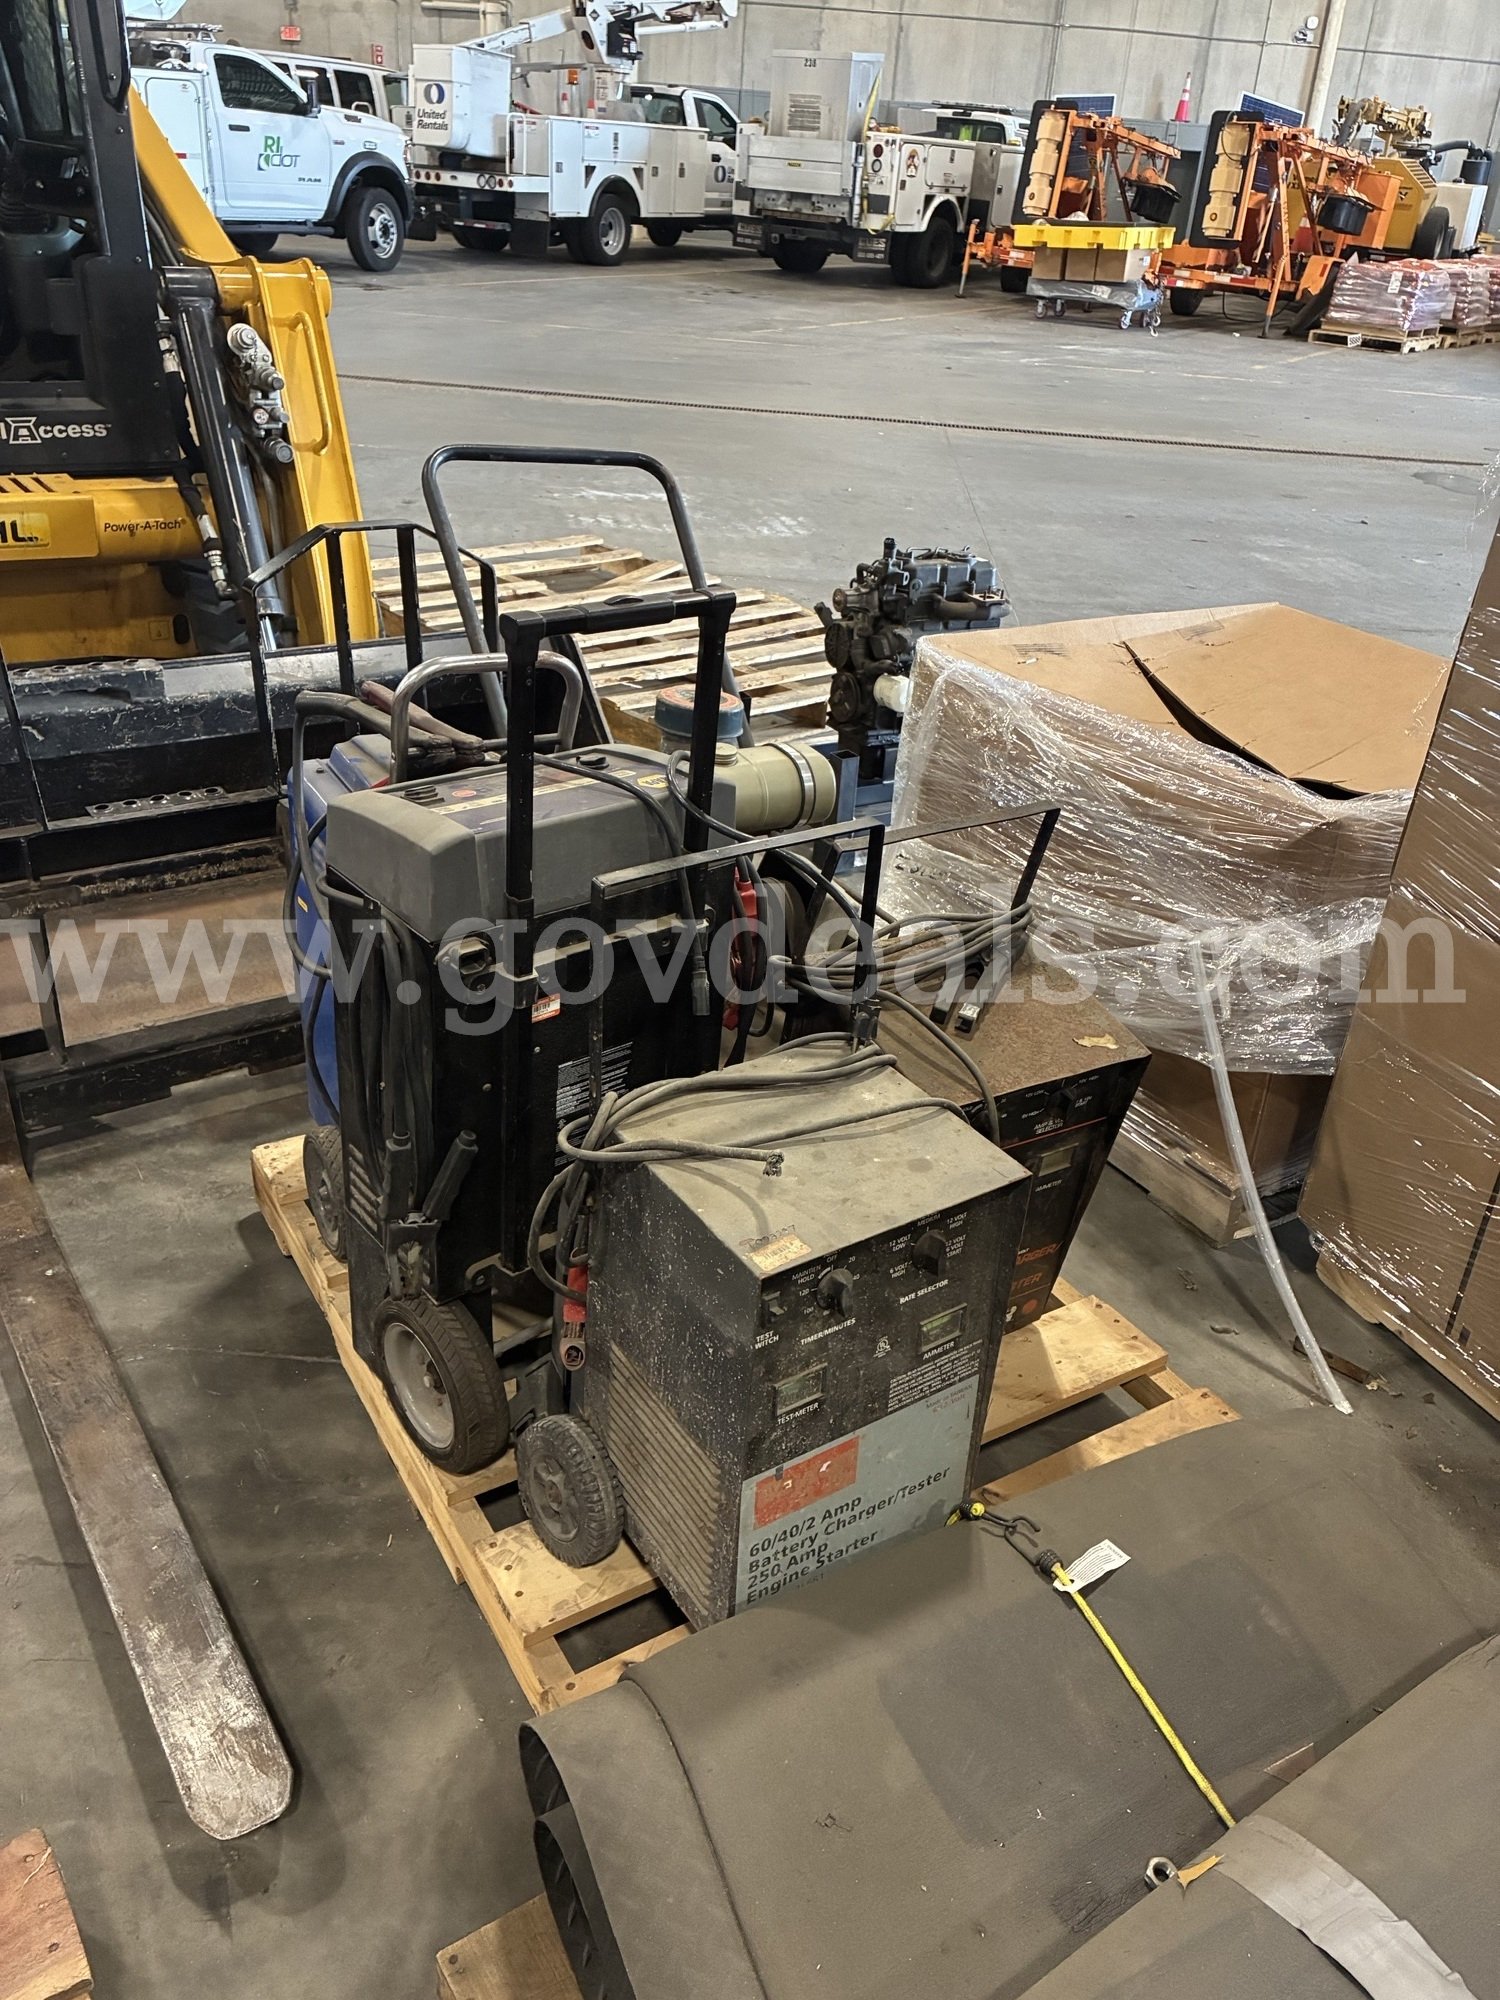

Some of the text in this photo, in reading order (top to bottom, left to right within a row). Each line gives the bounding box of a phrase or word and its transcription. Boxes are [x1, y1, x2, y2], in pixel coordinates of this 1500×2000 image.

[417, 109, 447, 120] United
[416, 119, 448, 131] Rentals
[264, 136, 281, 153] RI
[104, 519, 182, 533] Power-A-Tach
[1035, 1179, 1063, 1192] AMMETER
[917, 1213, 941, 1227] MEDIUM
[954, 1212, 968, 1223] VOLT
[896, 1234, 911, 1246] VOLT
[950, 1241, 964, 1251] VOLT
[953, 1234, 966, 1246] VOLT
[892, 1242, 906, 1252] LOW
[826, 1255, 838, 1263] OFF
[894, 1262, 908, 1272] VOLT
[798, 1273, 815, 1284] HOLD
[891, 1269, 906, 1279] HIGH
[799, 1288, 810, 1297] 120
[900, 1278, 949, 1304] RATE SELECTOR
[756, 1330, 774, 1342] TEST
[800, 1317, 856, 1345] TIMER/MINUTES
[922, 1341, 955, 1360] AMMETER
[748, 1467, 950, 1574] Battery Charger/Tester
[749, 1496, 862, 1558] 60/40/2 Amp
[747, 1567, 782, 1590] 250
[787, 1541, 829, 1575] Amp
[747, 1565, 811, 1606] Engine
[816, 1530, 879, 1570] Starter
